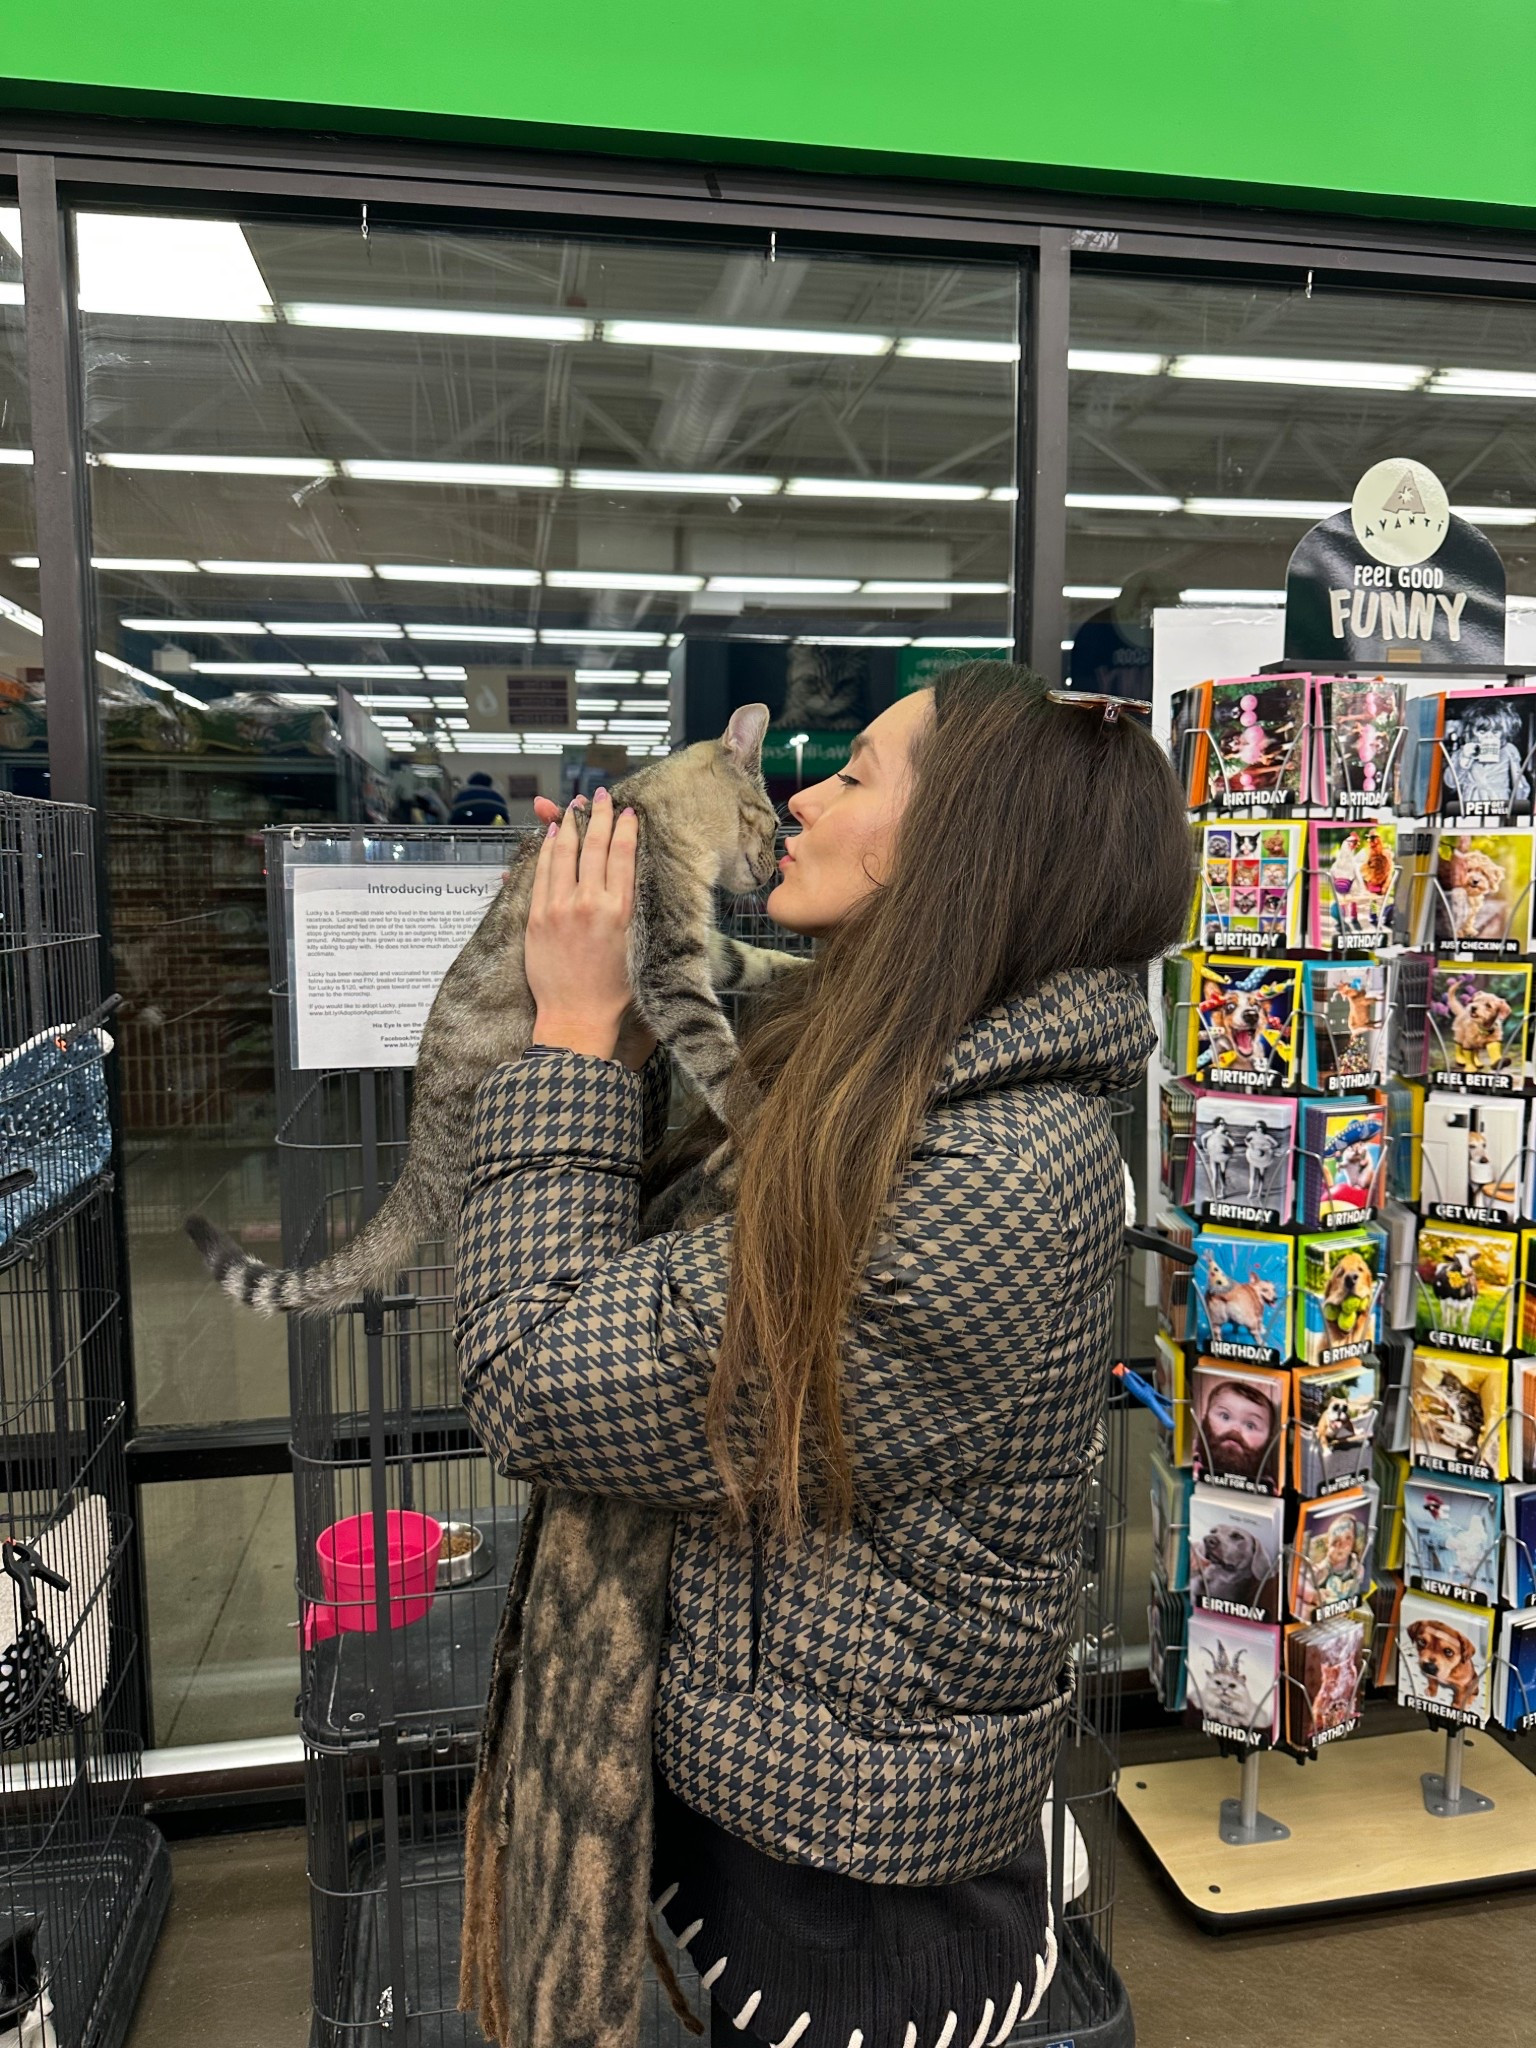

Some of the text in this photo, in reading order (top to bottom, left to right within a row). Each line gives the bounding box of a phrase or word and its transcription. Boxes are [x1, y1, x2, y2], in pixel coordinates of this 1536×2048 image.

[1398, 567, 1443, 589] GOOD
[1329, 588, 1467, 641] FUNNY
[1223, 790, 1288, 806] BIRTHDAY
[1466, 802, 1490, 815] PET
[368, 883, 488, 896] Introducing Lucky!
[1215, 932, 1279, 947] BIRTHDAY
[1211, 1068, 1275, 1087] BIRTHDAY
[1466, 1074, 1510, 1088] BETTER
[1209, 1202, 1272, 1223] BIRTHDAY
[1327, 1207, 1372, 1227] BRTHDAY
[1436, 1204, 1462, 1218] GET
[1429, 1330, 1456, 1346] GET
[1323, 1341, 1369, 1364] BRTHDAY
[1448, 1461, 1490, 1480] BETTER
